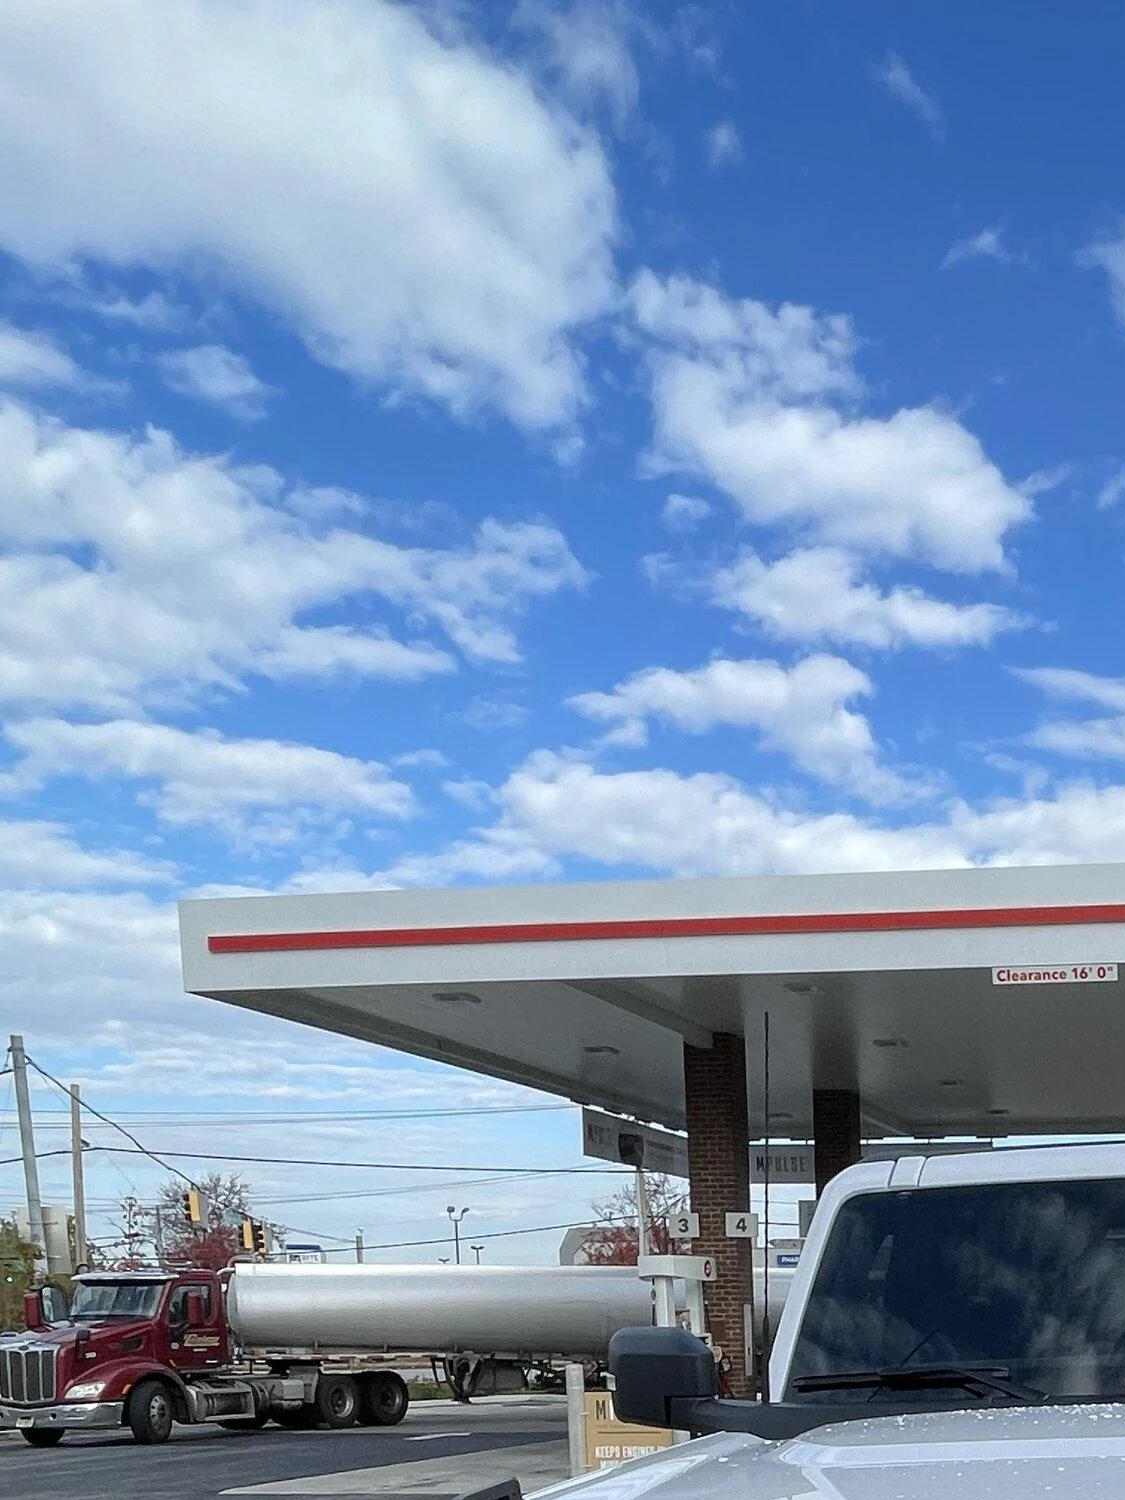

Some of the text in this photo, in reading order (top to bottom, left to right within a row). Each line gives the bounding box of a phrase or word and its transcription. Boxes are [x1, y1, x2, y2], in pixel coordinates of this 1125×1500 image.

[996, 969, 1067, 982] Clearance
[678, 1217, 689, 1233] 3
[735, 1217, 748, 1232] 4
[595, 1446, 620, 1459] KEEPS
